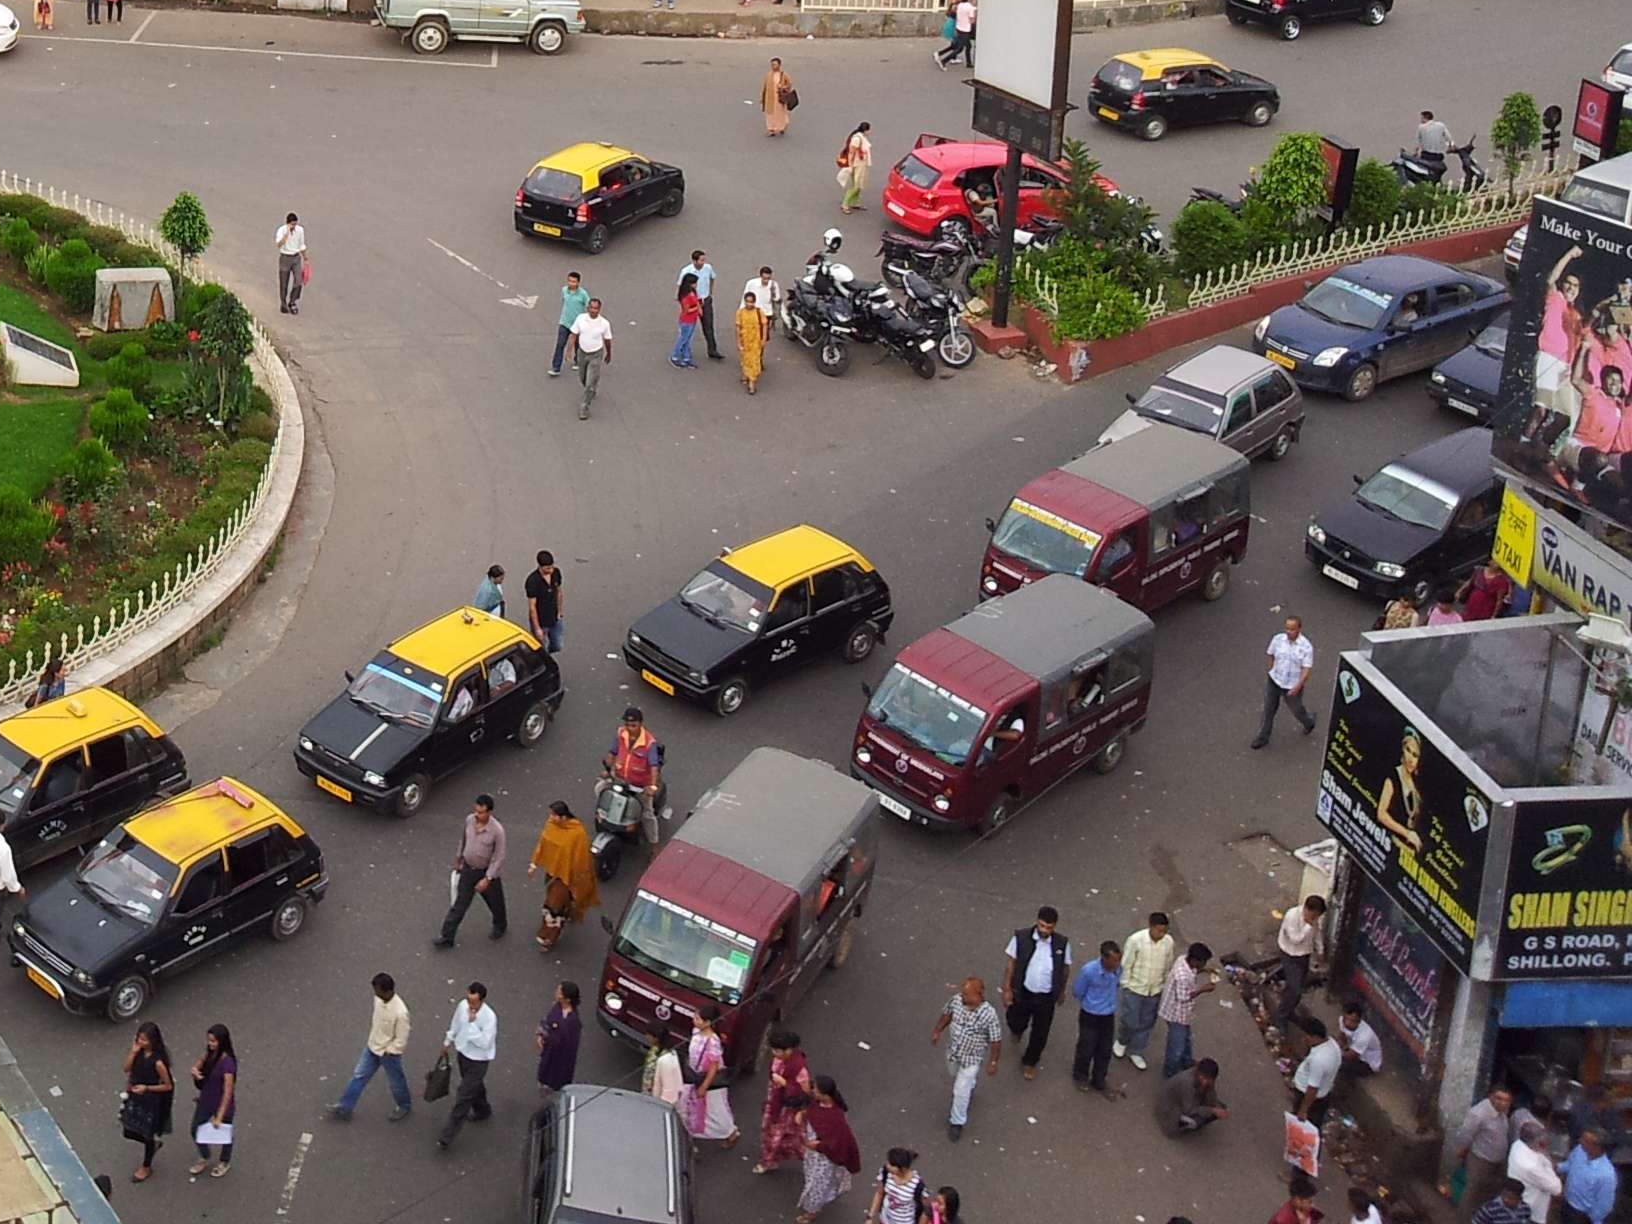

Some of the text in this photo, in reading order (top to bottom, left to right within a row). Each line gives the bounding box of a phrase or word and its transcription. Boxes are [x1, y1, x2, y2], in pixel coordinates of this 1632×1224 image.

[1539, 214, 1582, 241] Make
[1585, 229, 1624, 255] Your
[1503, 543, 1522, 575] TAXI
[1541, 542, 1577, 593] VAN
[1582, 573, 1621, 617] RAP
[1321, 768, 1353, 812] Sham
[1352, 801, 1392, 852] Jewels
[1508, 892, 1572, 929] SHAM
[1524, 936, 1539, 950] G
[1543, 935, 1557, 949] S
[1561, 934, 1620, 950] ROAD,
[1507, 953, 1611, 970] SHILLONG.
